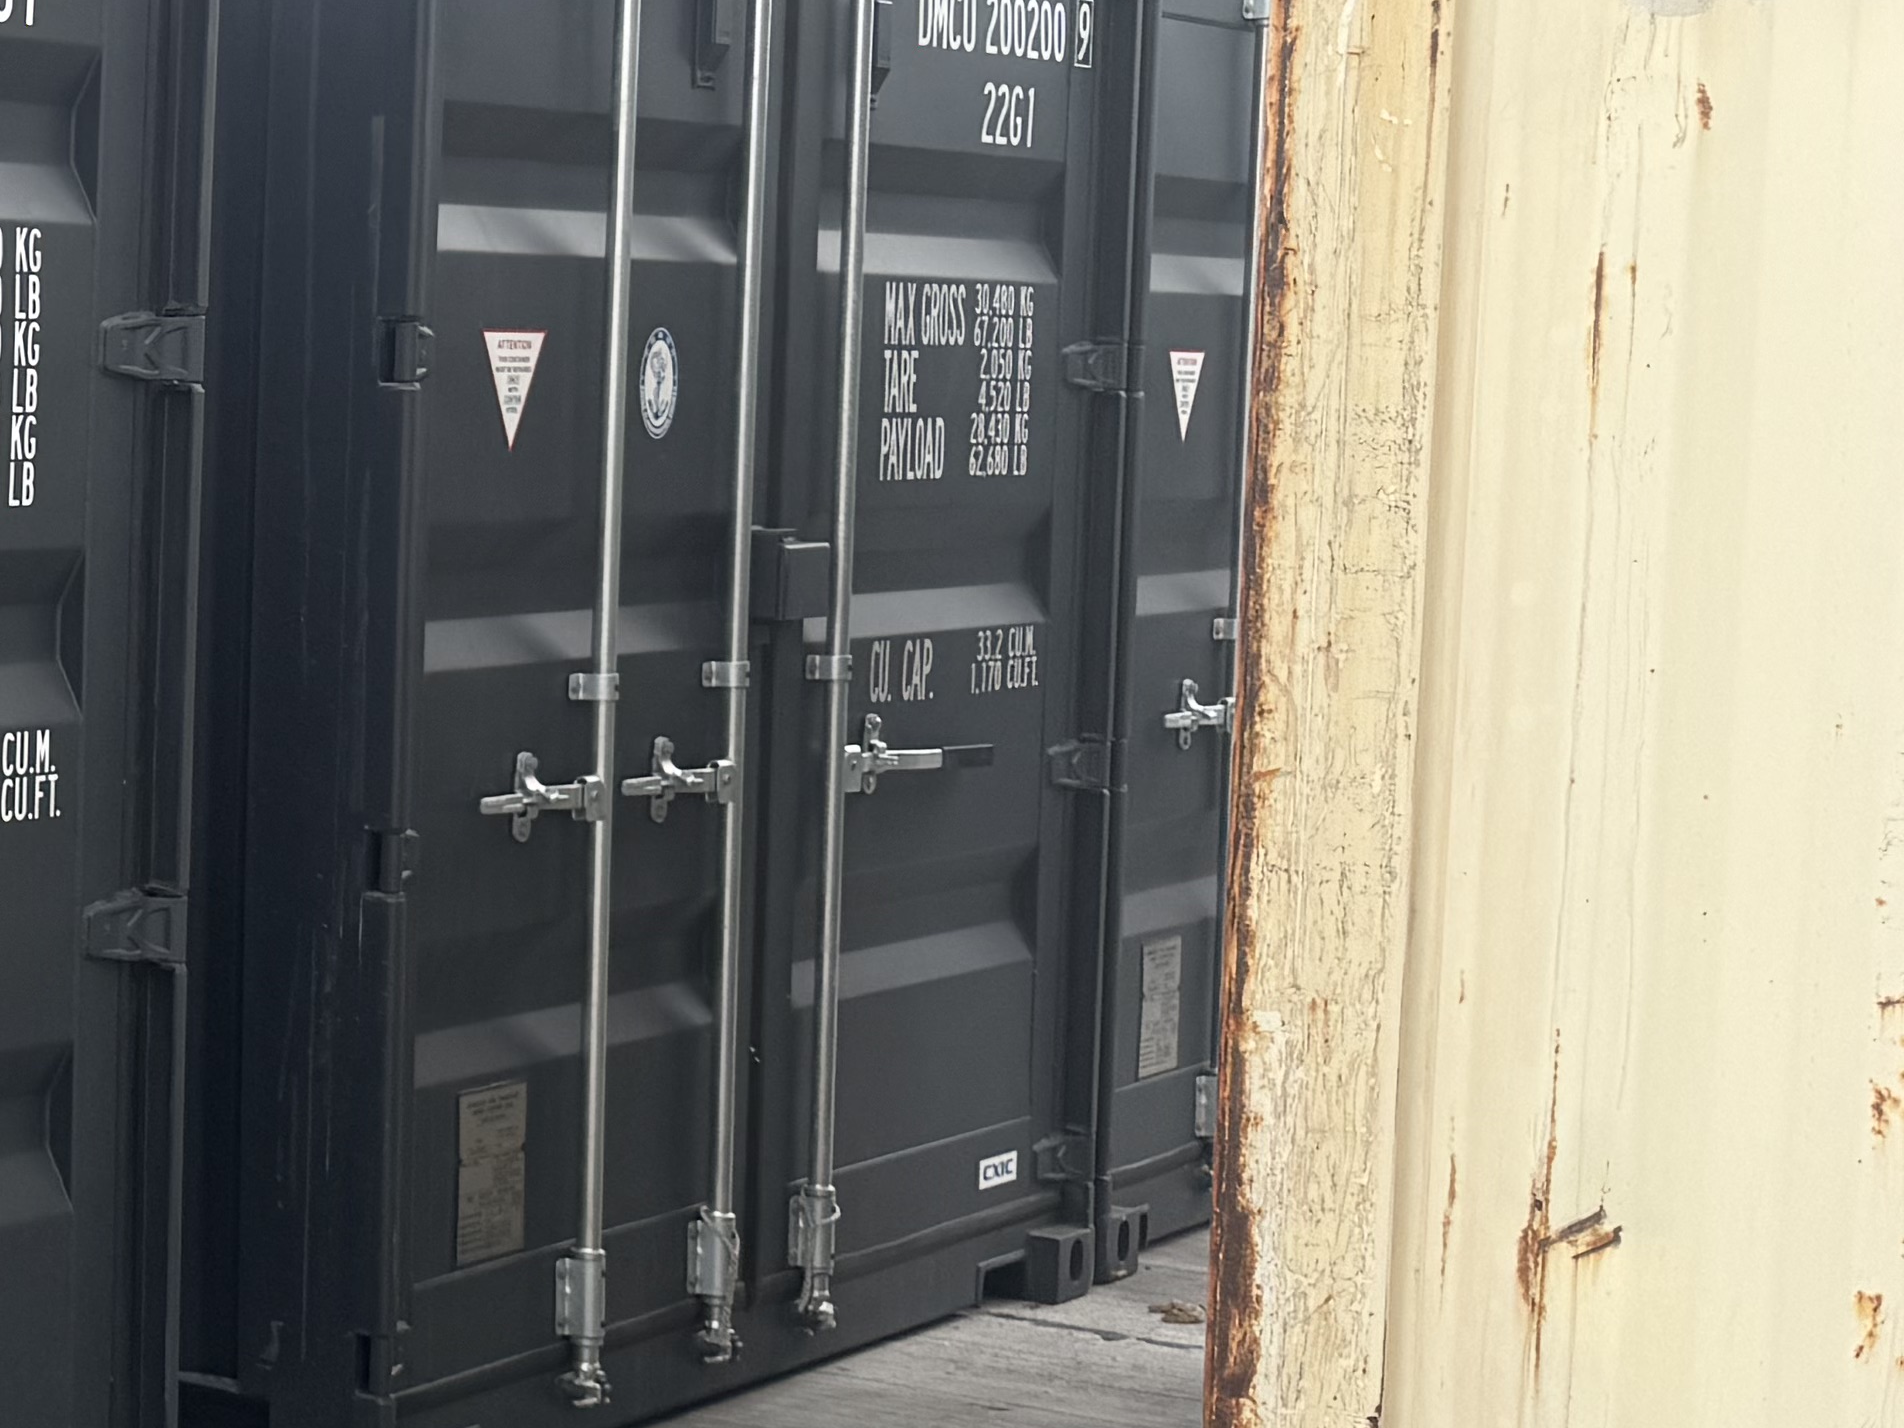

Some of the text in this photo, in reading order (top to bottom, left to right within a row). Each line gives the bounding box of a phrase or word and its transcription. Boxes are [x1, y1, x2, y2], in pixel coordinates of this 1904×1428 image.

[1076, 1, 1093, 63] 9
[981, 82, 1035, 148] 22G1
[15, 227, 41, 272] KG
[14, 274, 41, 320] LB
[884, 281, 966, 346] MAX GROSS
[13, 320, 40, 366] KG
[12, 368, 38, 413] LB
[884, 350, 919, 413] TARE
[10, 415, 37, 460] KG
[880, 417, 945, 481] PAYLOAD
[8, 462, 35, 507] LB
[870, 638, 934, 703] CU. CAP.
[2, 729, 56, 776] CU.M.
[0, 774, 61, 822] CU.FT.
